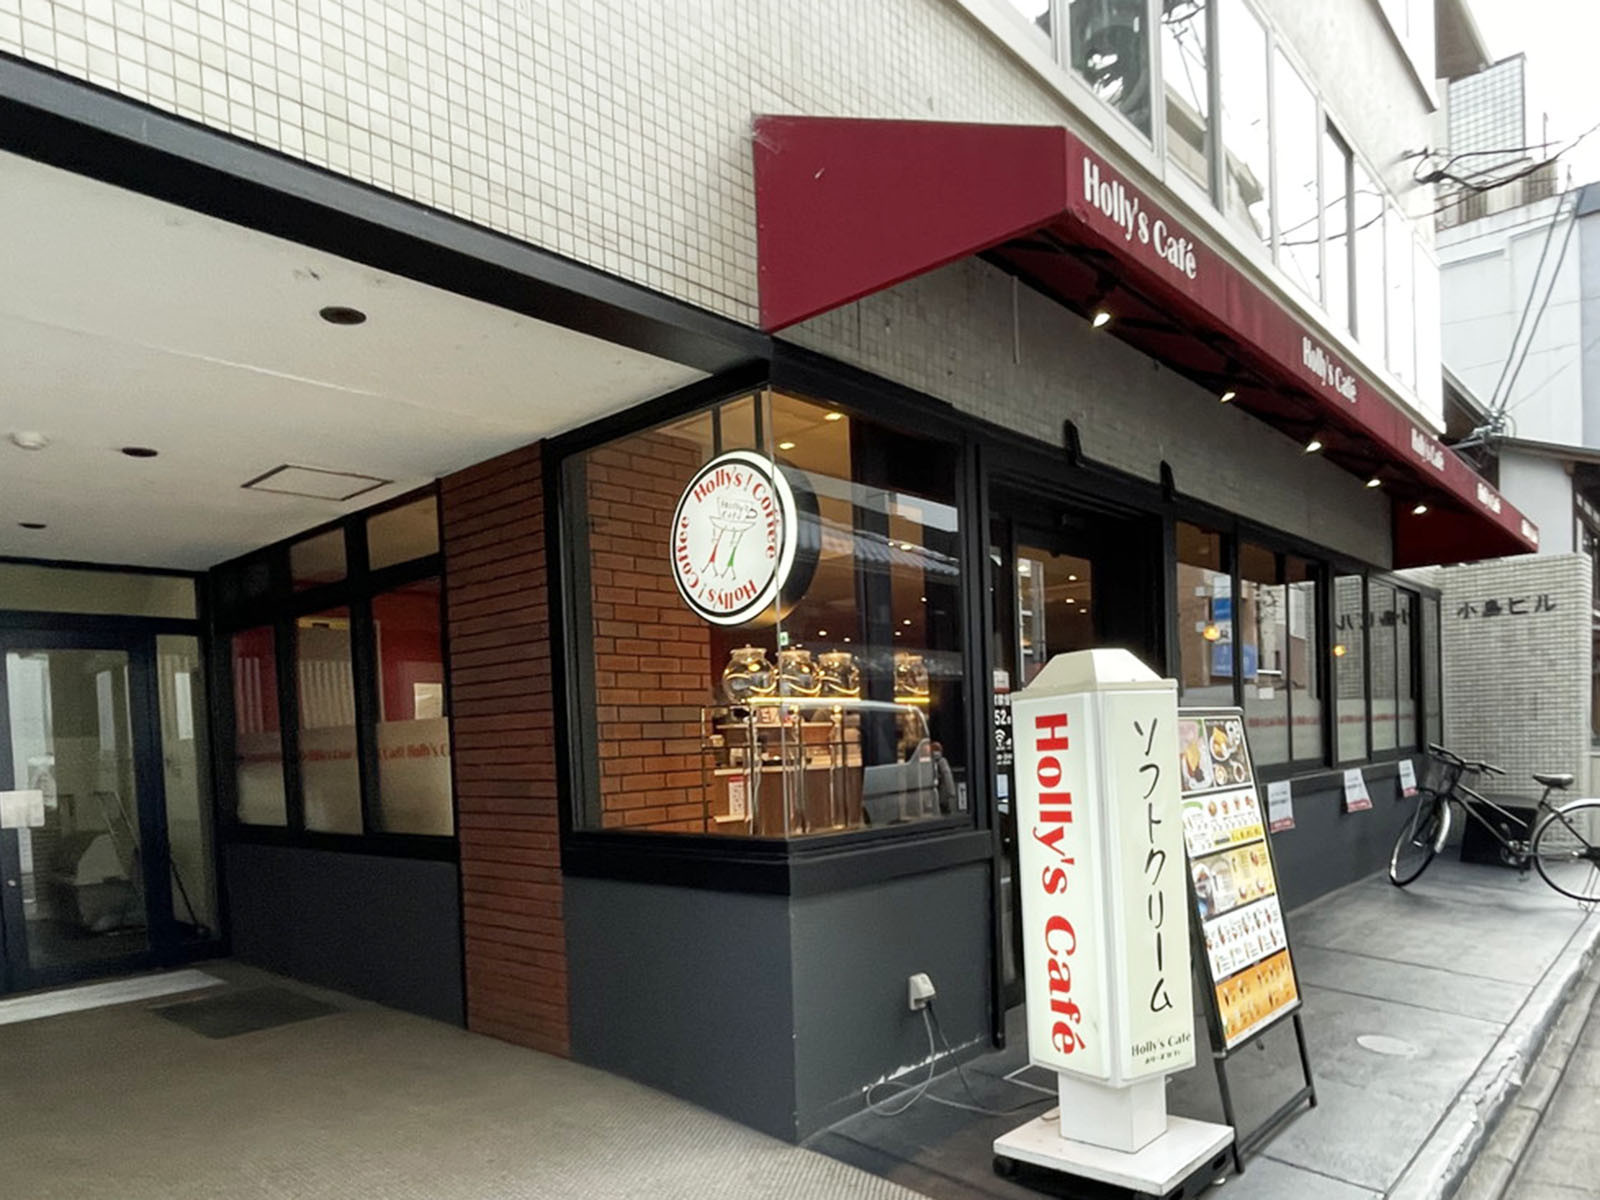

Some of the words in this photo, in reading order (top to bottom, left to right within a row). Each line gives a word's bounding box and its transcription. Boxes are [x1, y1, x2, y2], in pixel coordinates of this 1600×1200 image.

[1083, 156, 1149, 244] Holly's
[1153, 219, 1197, 279] Café
[1032, 713, 1075, 895] Holly's
[1134, 718, 1173, 1013] ソフトクリーム
[1045, 915, 1086, 1055] Café
